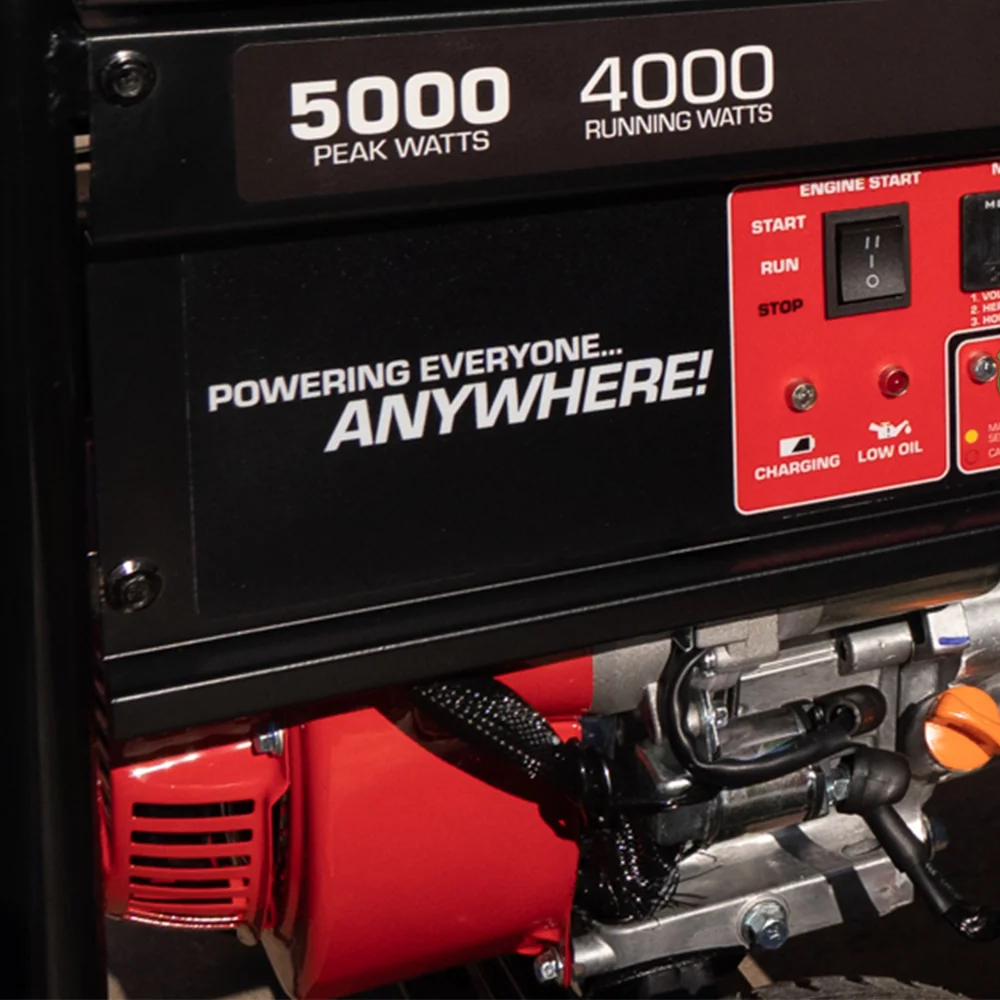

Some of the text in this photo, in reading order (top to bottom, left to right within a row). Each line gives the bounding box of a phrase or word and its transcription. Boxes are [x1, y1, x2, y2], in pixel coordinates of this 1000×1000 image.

[580, 44, 775, 112] 4000
[290, 66, 510, 140] 5000
[585, 103, 774, 140] RUNNING WATTS
[313, 130, 491, 166] PEAK WATTS
[800, 171, 922, 197] ENGINE START
[751, 214, 806, 235] START
[760, 258, 799, 275] RUN
[758, 298, 803, 317] STOP
[208, 333, 623, 412] POWERING EVERYONE...
[324, 349, 714, 452] ANYWHERE!
[754, 454, 840, 480] CHARGING
[858, 440, 923, 464] LOW OIL
